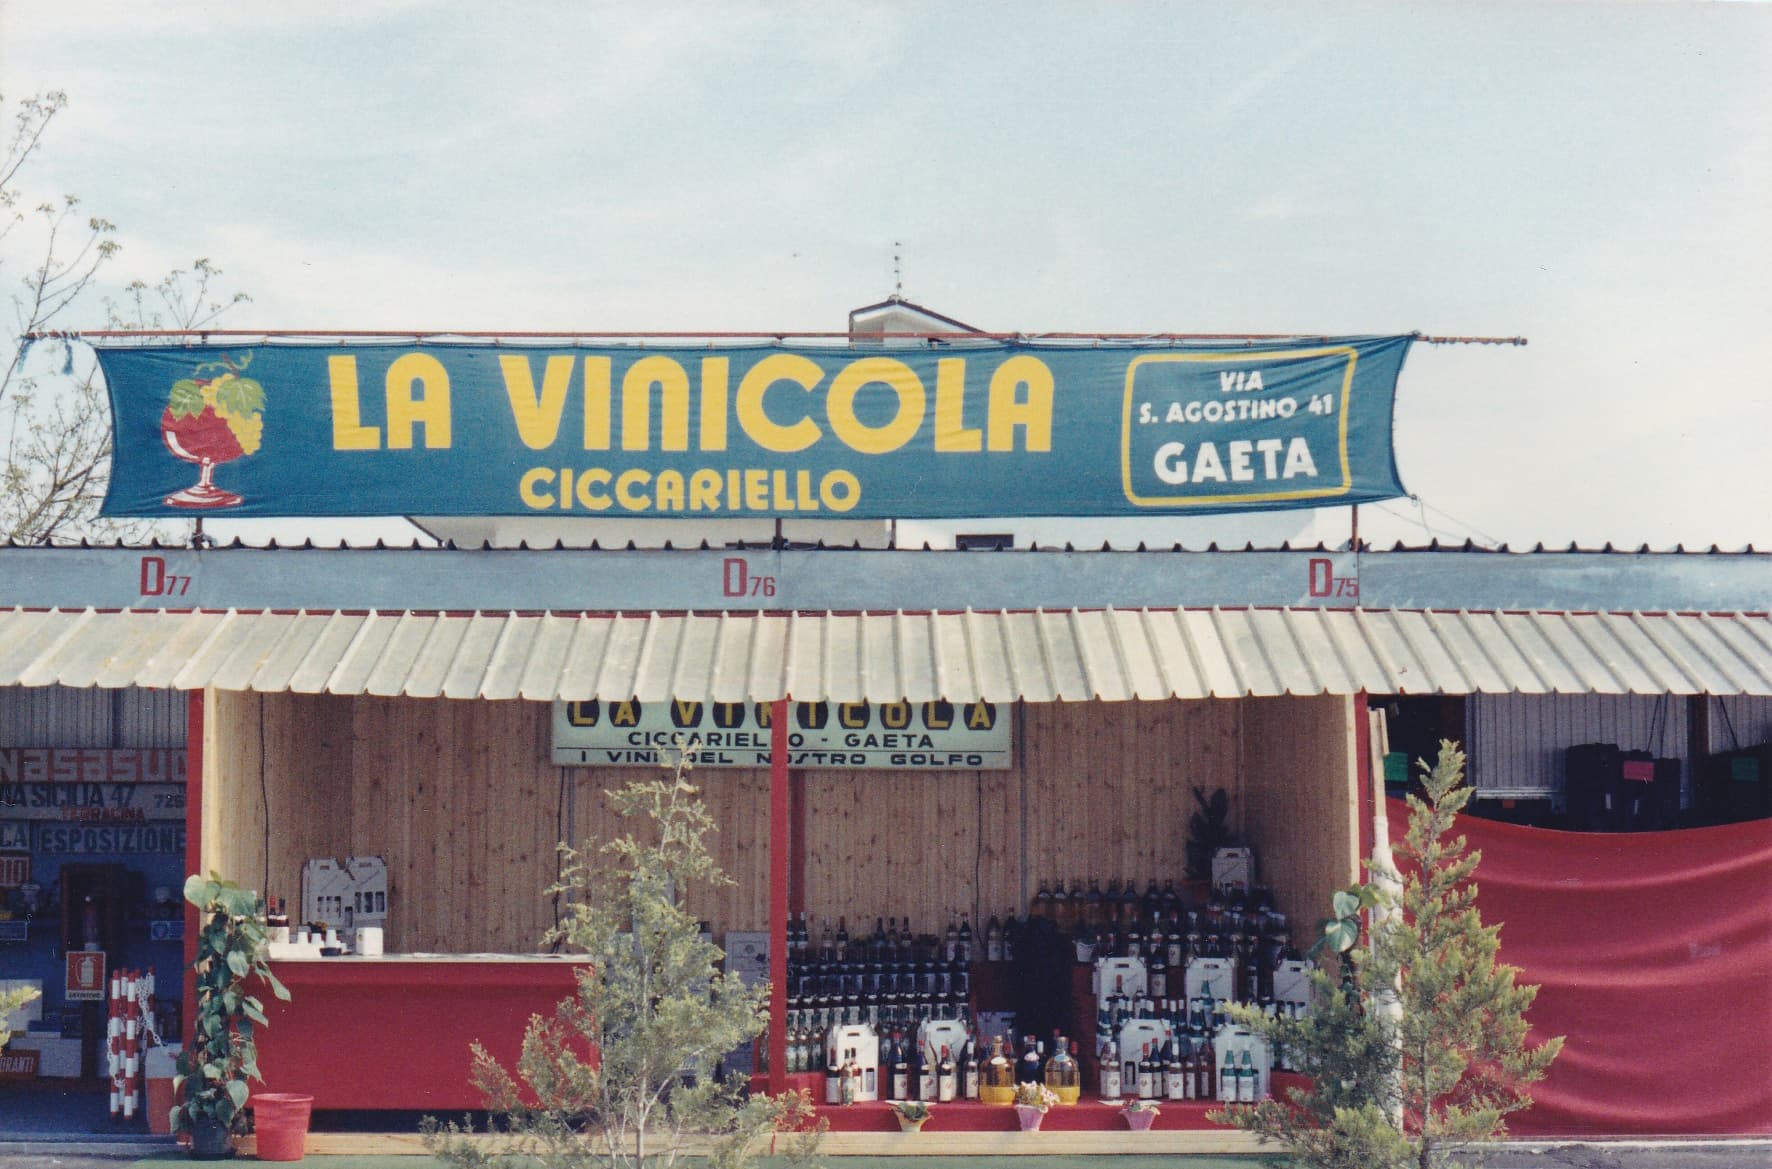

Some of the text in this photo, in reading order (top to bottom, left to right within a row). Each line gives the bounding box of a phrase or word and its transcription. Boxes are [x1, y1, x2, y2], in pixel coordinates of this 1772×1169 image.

[1220, 371, 1264, 392] VIA
[328, 352, 1055, 455] LA VINICOLA
[1139, 394, 1334, 424] S. AGOSTINO 41
[1153, 437, 1318, 485] GAETA
[519, 466, 861, 513] CICCARIELLO
[140, 556, 192, 596] D77
[723, 558, 776, 598] D76
[1309, 558, 1360, 598] D75
[573, 701, 637, 726] LA
[628, 732, 804, 748] CICCARIELO
[845, 733, 934, 748] GAETA
[581, 751, 586, 762] I
[606, 751, 659, 763] VINI
[757, 752, 866, 765] NSTRO
[890, 754, 983, 766] GOLFO
[42, 826, 186, 852] ESPOSIZIONE
